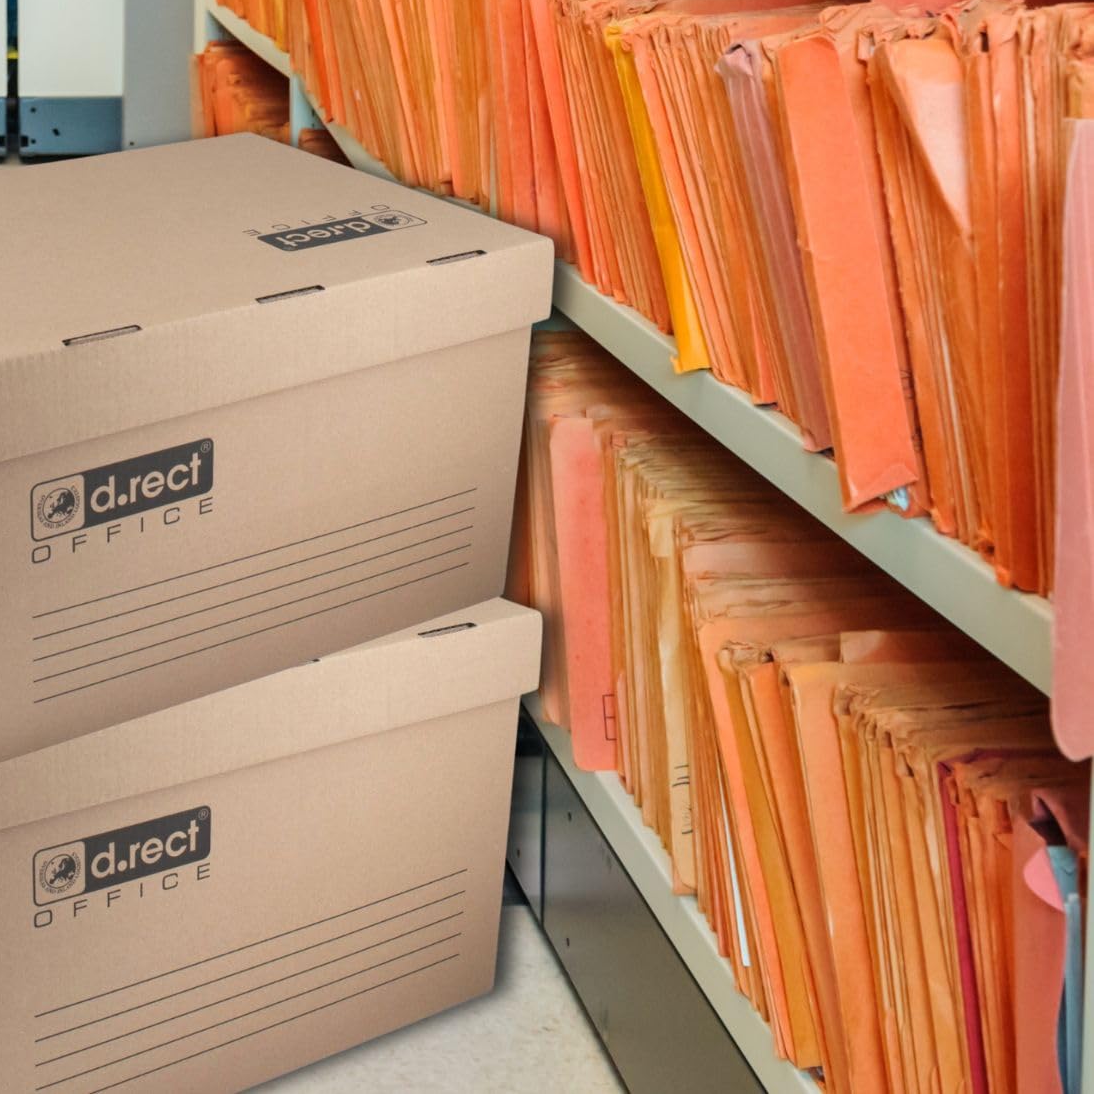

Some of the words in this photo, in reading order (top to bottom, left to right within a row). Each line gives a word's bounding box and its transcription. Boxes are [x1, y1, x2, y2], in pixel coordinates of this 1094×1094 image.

[242, 204, 391, 237] OFFICE
[31, 496, 213, 564] OFFICE
[33, 862, 210, 928] OFFICE
